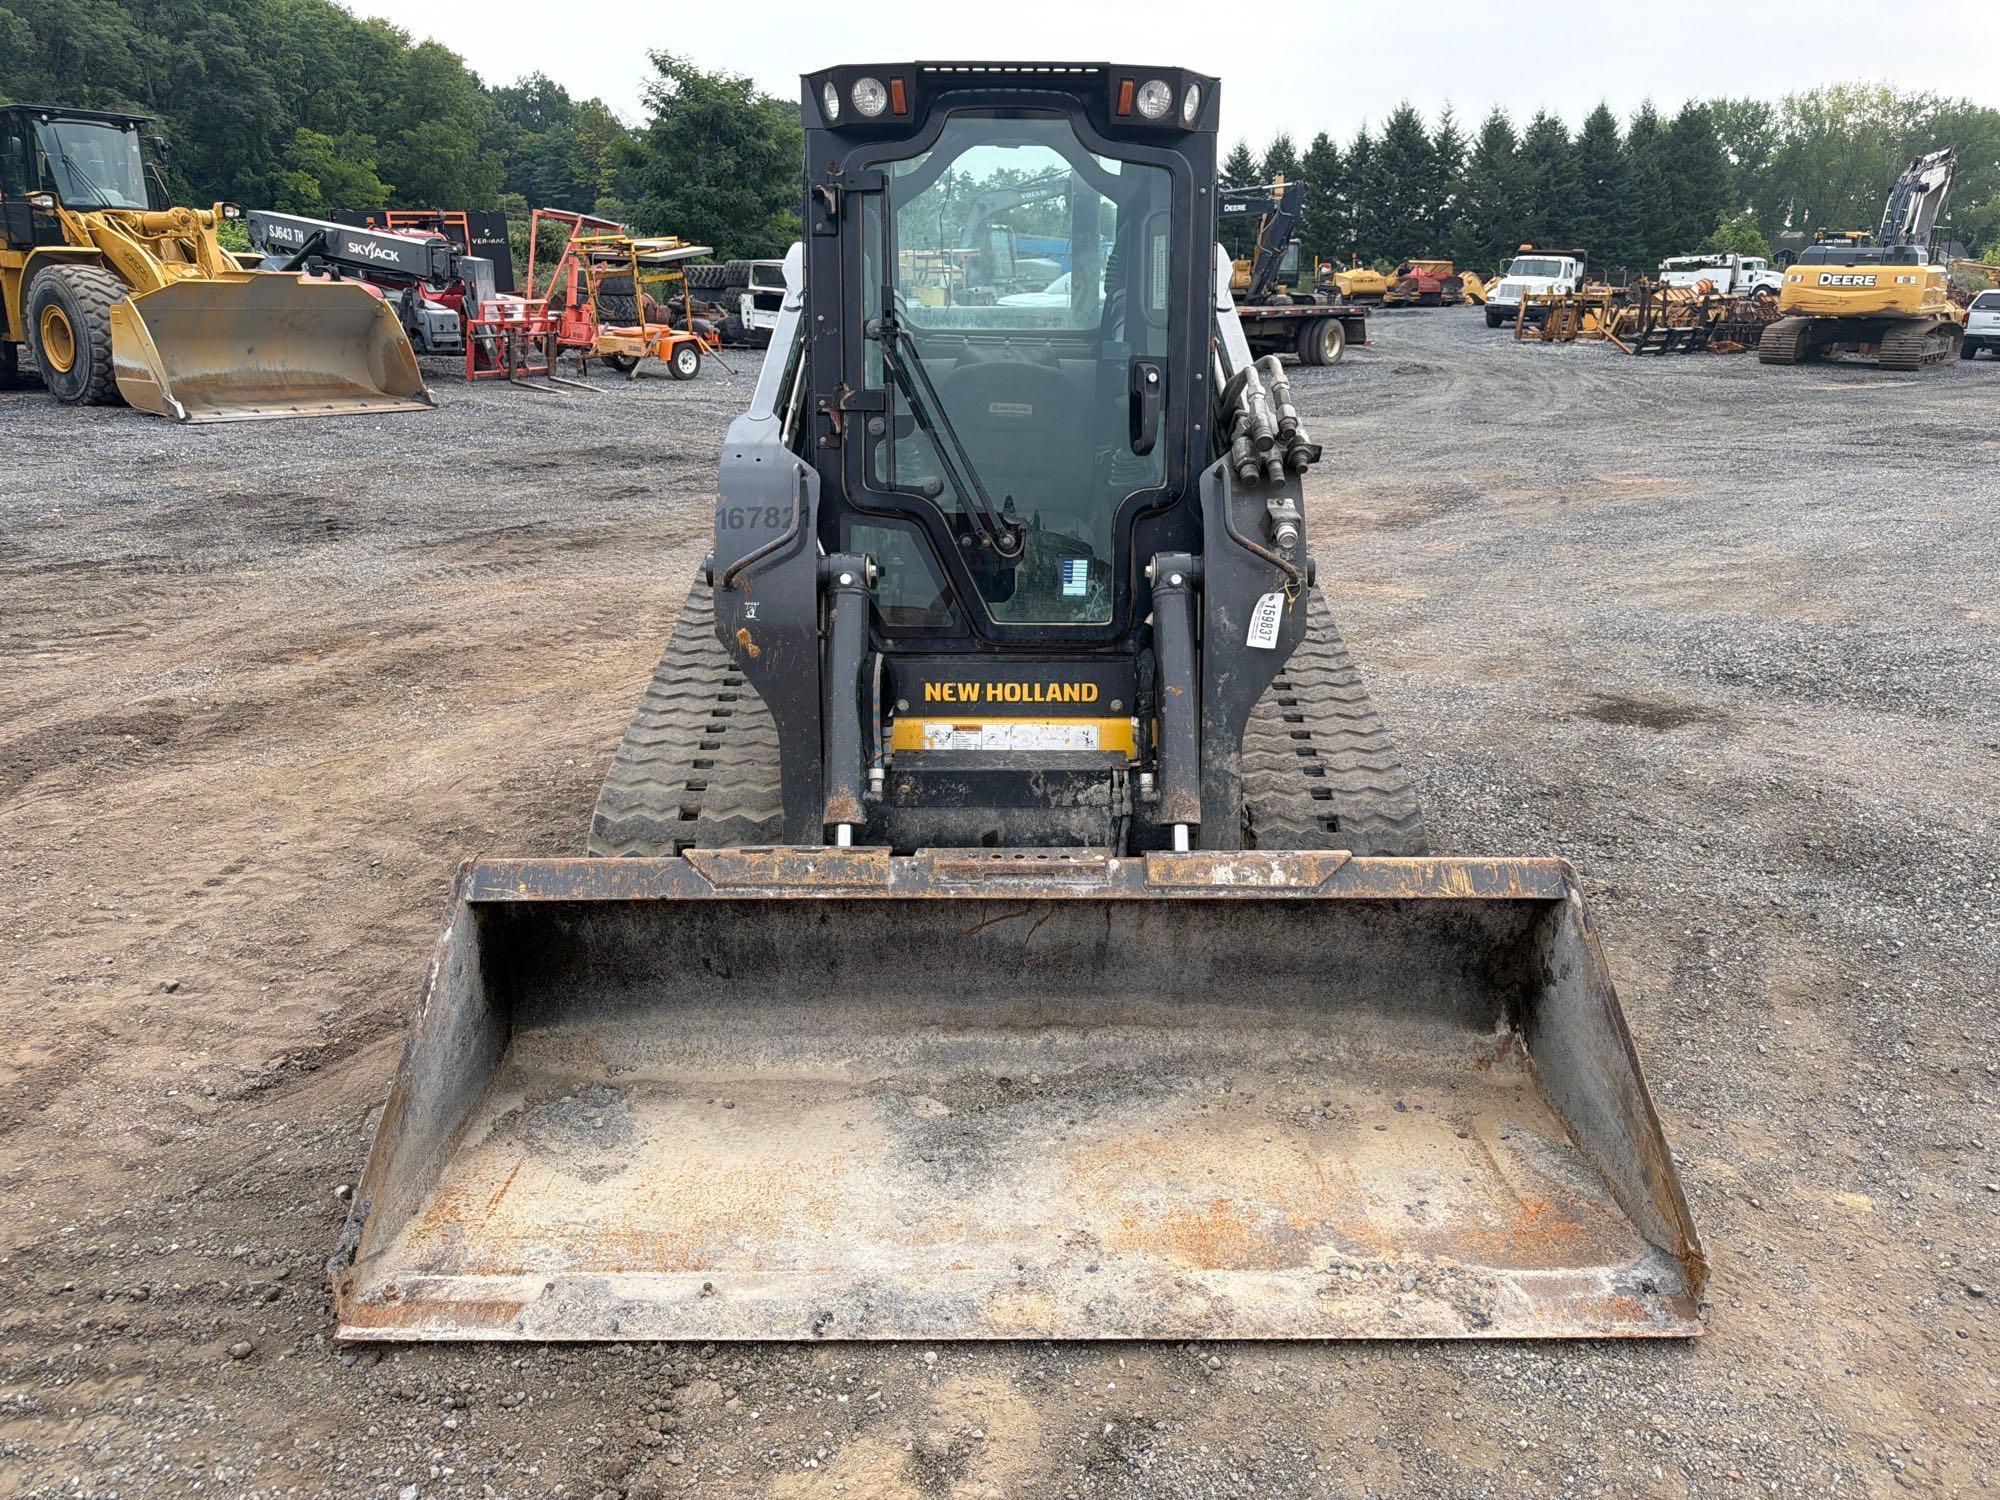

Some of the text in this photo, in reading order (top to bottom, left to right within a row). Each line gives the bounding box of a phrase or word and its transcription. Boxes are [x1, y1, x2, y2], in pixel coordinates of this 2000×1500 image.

[1224, 203, 1247, 212] DEERE
[269, 224, 304, 243] SJ643 TH
[348, 241, 400, 262] SKYJACK
[1819, 273, 1876, 286] DEERE
[1258, 604, 1277, 641] 159837
[924, 682, 1099, 702] NEW HOLLAND
